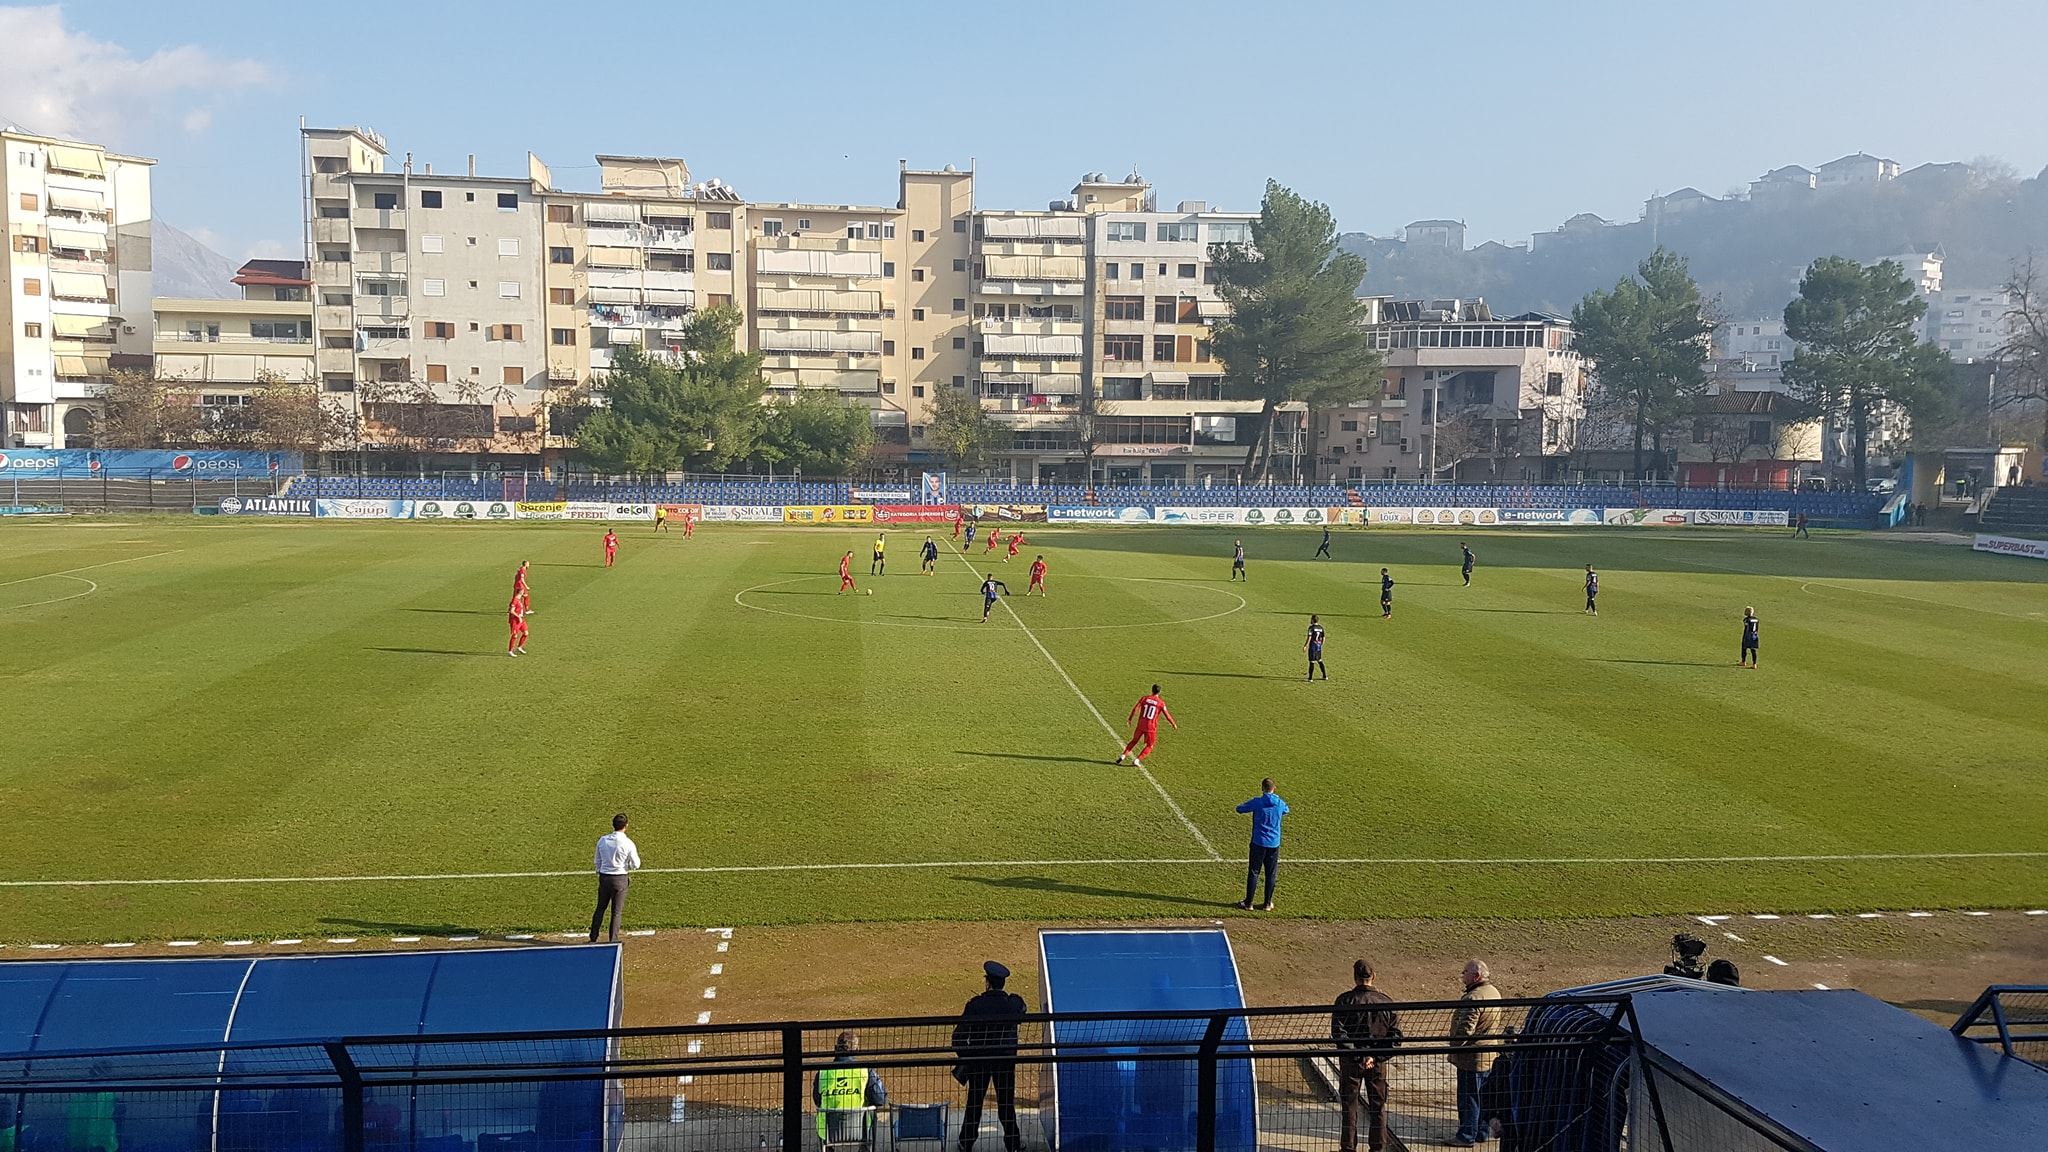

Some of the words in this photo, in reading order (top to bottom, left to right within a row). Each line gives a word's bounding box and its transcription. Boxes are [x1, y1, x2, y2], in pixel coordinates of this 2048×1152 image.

[13, 457, 58, 471] pepsi
[197, 458, 240, 472] pepsi
[245, 499, 311, 512] ATLANTIK
[345, 505, 388, 515] Cajupi
[520, 504, 562, 512] gorenje
[741, 507, 772, 516] SIGAL
[1053, 508, 1116, 518] e-network
[1181, 512, 1235, 520] ALSPER
[1504, 511, 1565, 520] e-network
[1710, 511, 1742, 521] SIGAL
[1143, 704, 1157, 720] 10
[823, 1087, 861, 1097] LEGEA
